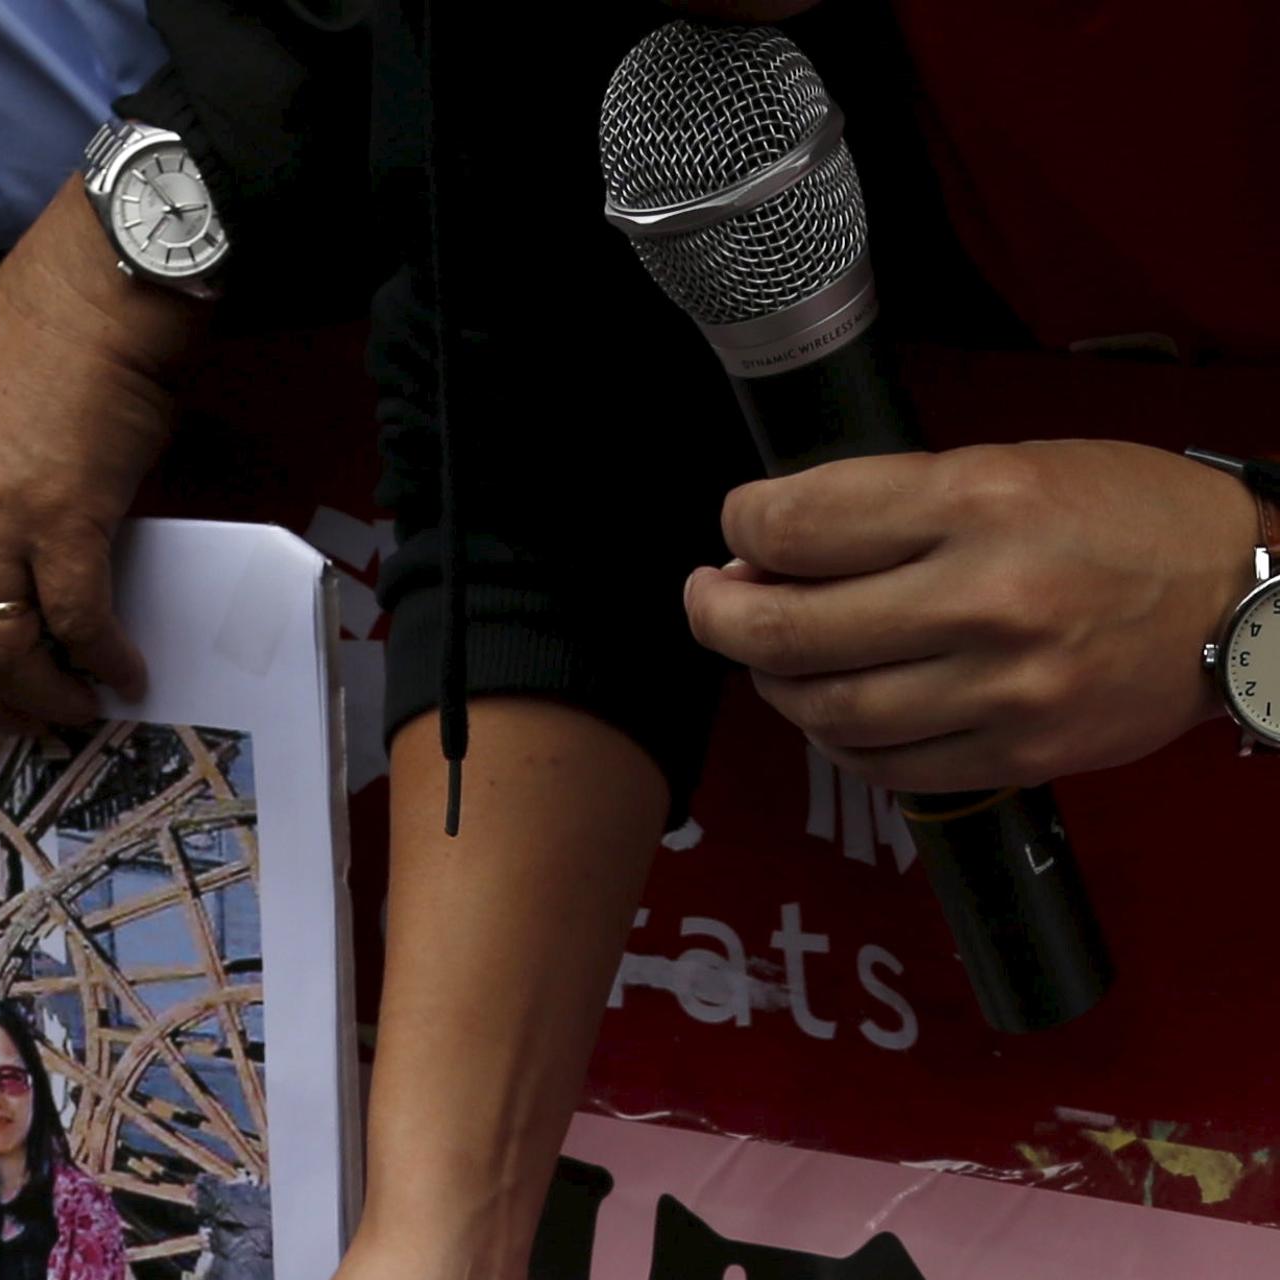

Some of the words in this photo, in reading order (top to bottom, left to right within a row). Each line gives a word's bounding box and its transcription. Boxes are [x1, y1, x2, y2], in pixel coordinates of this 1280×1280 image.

[741, 348, 797, 370] DYNAMIC
[798, 320, 854, 356] WIRELESS
[1249, 622, 1262, 637] 4
[1239, 651, 1251, 667] 3
[1245, 681, 1257, 697] 2
[607, 899, 921, 1052] rats
